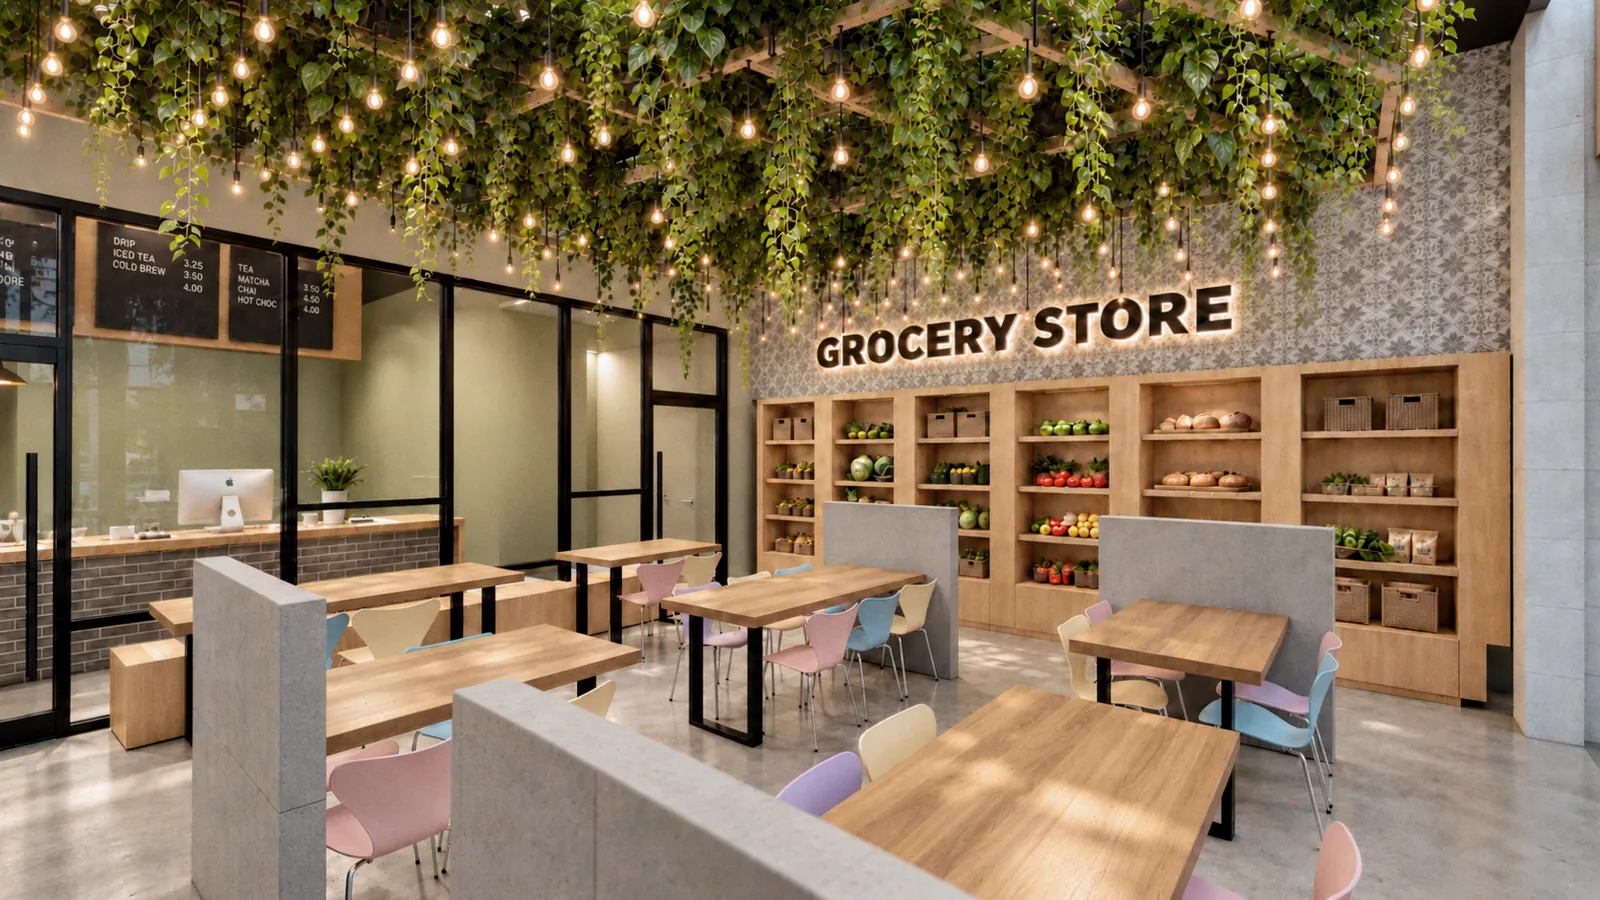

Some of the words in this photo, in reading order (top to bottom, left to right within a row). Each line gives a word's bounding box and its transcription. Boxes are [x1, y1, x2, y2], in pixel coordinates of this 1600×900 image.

[114, 237, 136, 248] DRIP
[113, 249, 135, 260] ICED
[137, 252, 155, 263] TEA
[113, 260, 137, 271] COLD
[139, 264, 166, 276] BREW
[237, 263, 254, 274] TEA
[183, 270, 203, 281] 3.50
[237, 275, 270, 287] MATCHA
[183, 284, 203, 293] 4.00
[237, 296, 254, 305] HOT
[255, 298, 278, 308] CHOC
[303, 295, 320, 304] 4.50
[303, 306, 320, 314] 4.00
[816, 313, 1018, 369] GROCERY
[1033, 284, 1233, 349] STORE
